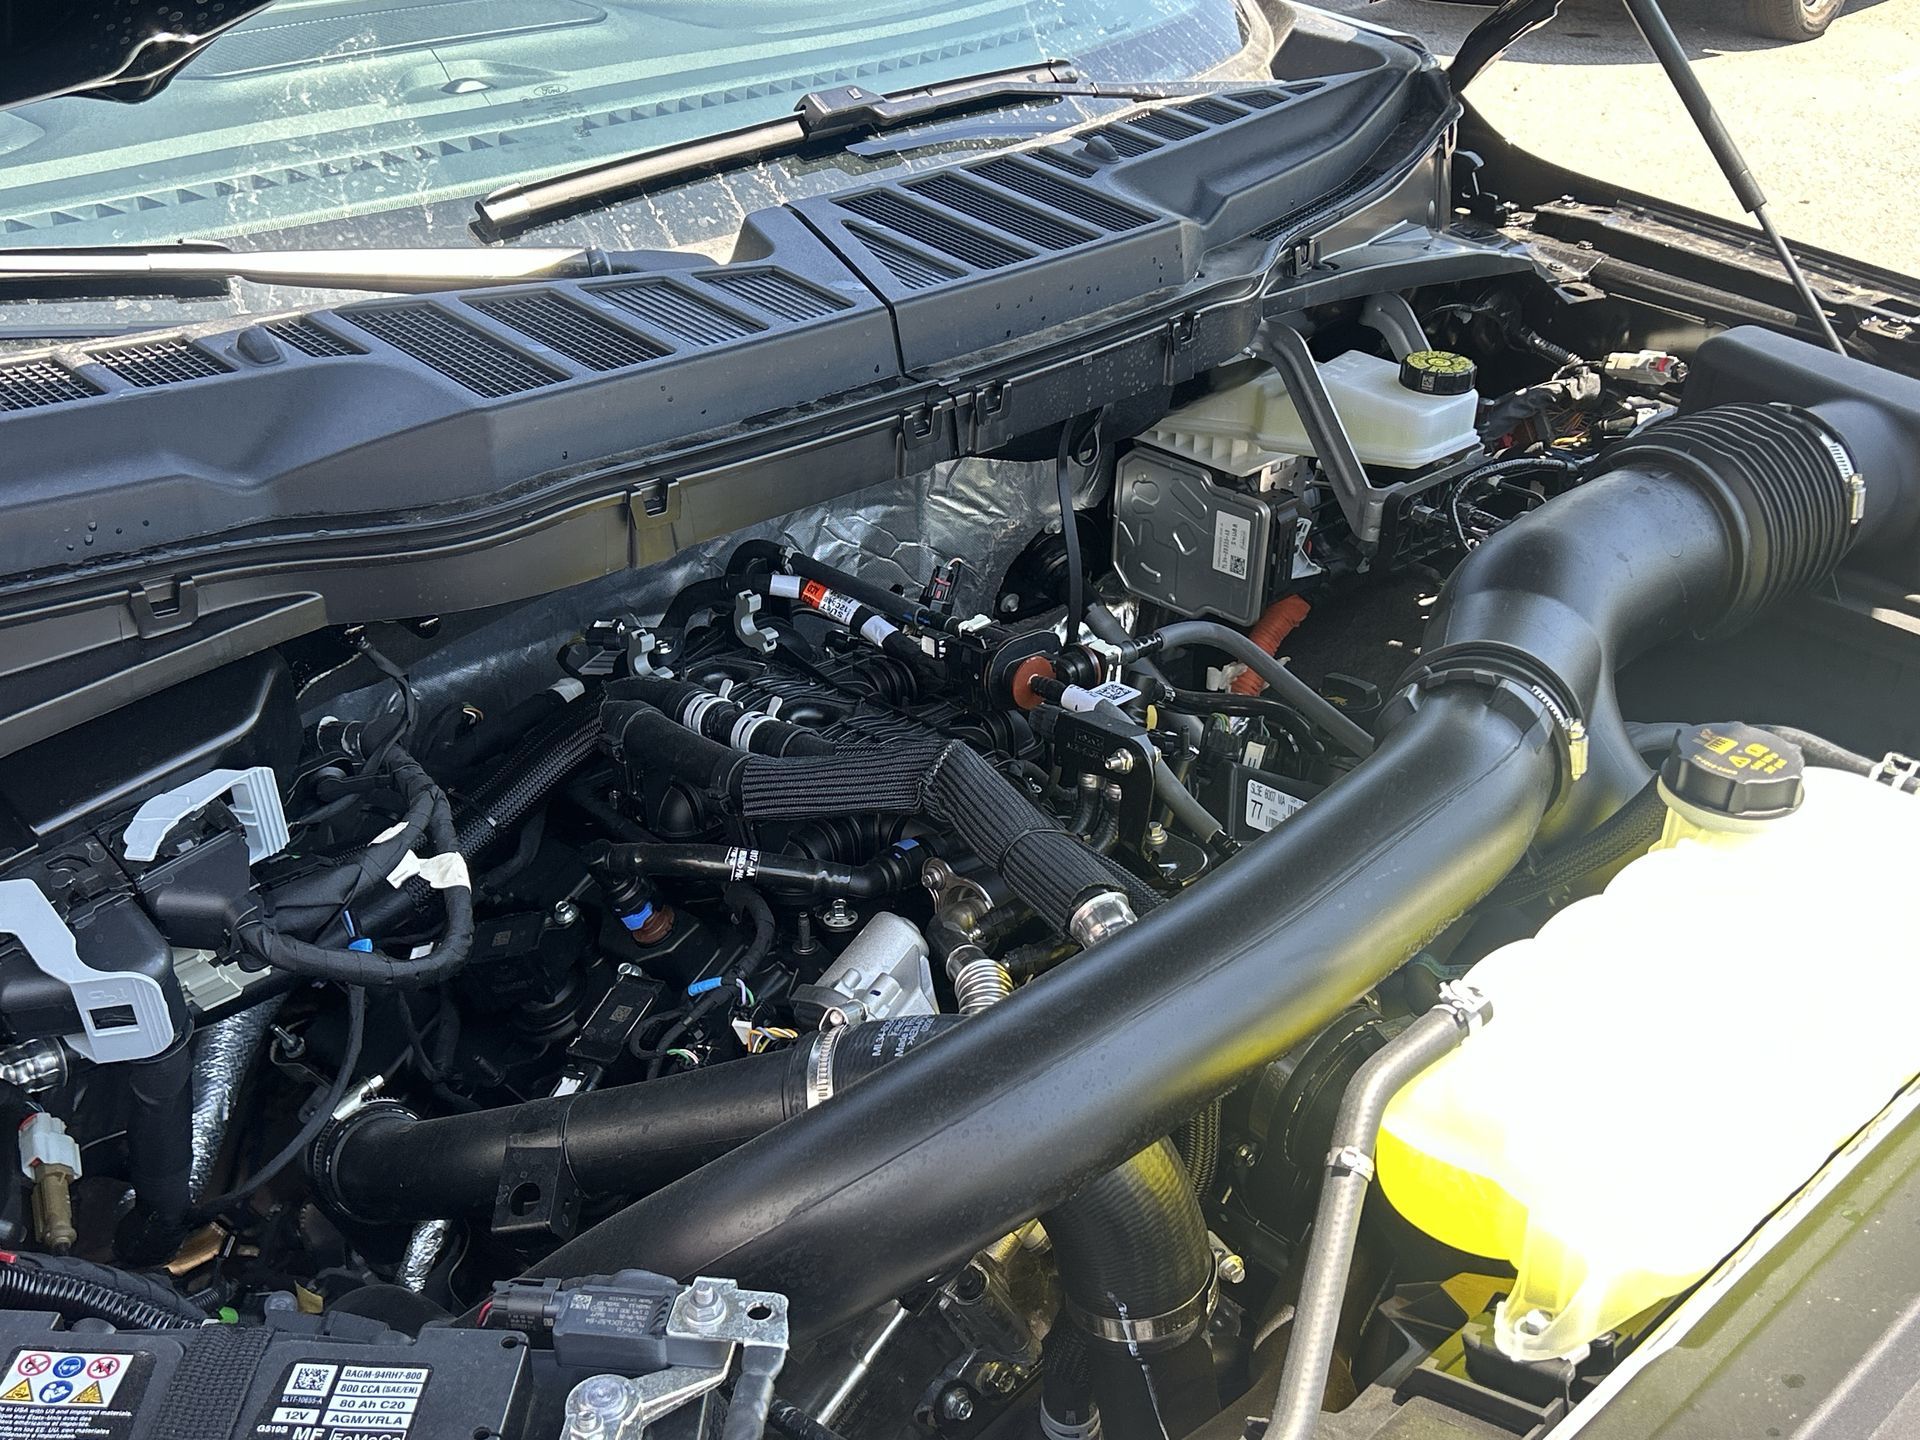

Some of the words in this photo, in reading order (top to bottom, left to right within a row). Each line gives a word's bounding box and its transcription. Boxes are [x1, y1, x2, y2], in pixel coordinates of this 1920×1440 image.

[1250, 799, 1263, 820] 77
[894, 1032, 909, 1057] Made
[340, 1383, 359, 1392] 800
[360, 1385, 380, 1394] CCA
[382, 1385, 418, 1394] (SAE/EN)
[339, 1399, 356, 1408] 80
[358, 1400, 376, 1409] Ah
[380, 1400, 406, 1409] C20
[284, 1411, 310, 1420] 12V
[330, 1414, 403, 1425] AGM/VRLA
